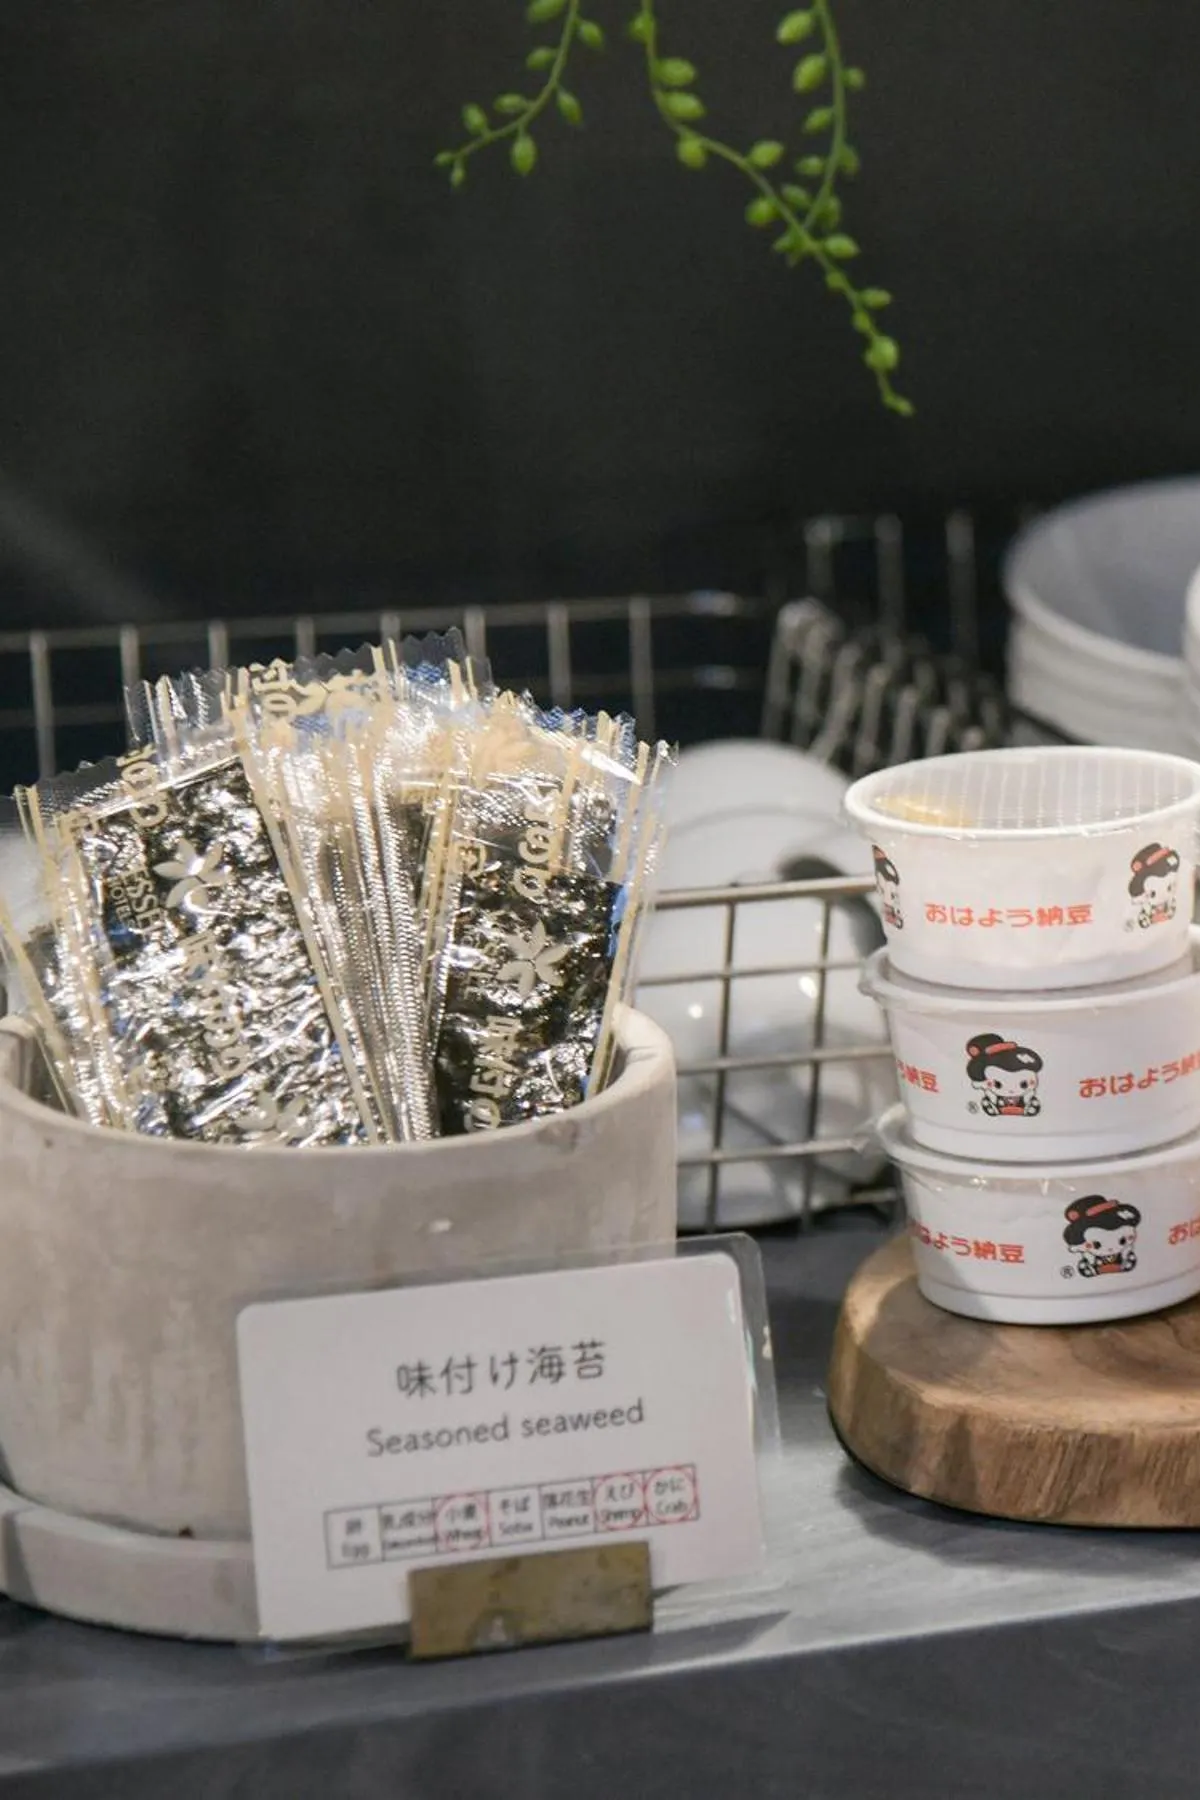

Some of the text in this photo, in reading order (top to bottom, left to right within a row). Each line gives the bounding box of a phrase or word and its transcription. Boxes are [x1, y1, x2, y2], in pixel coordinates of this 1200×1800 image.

[925, 903, 1095, 928] おはよう納豆
[396, 1340, 606, 1399] 味付け海苔
[367, 1398, 645, 1458] Seasoned seaweed
